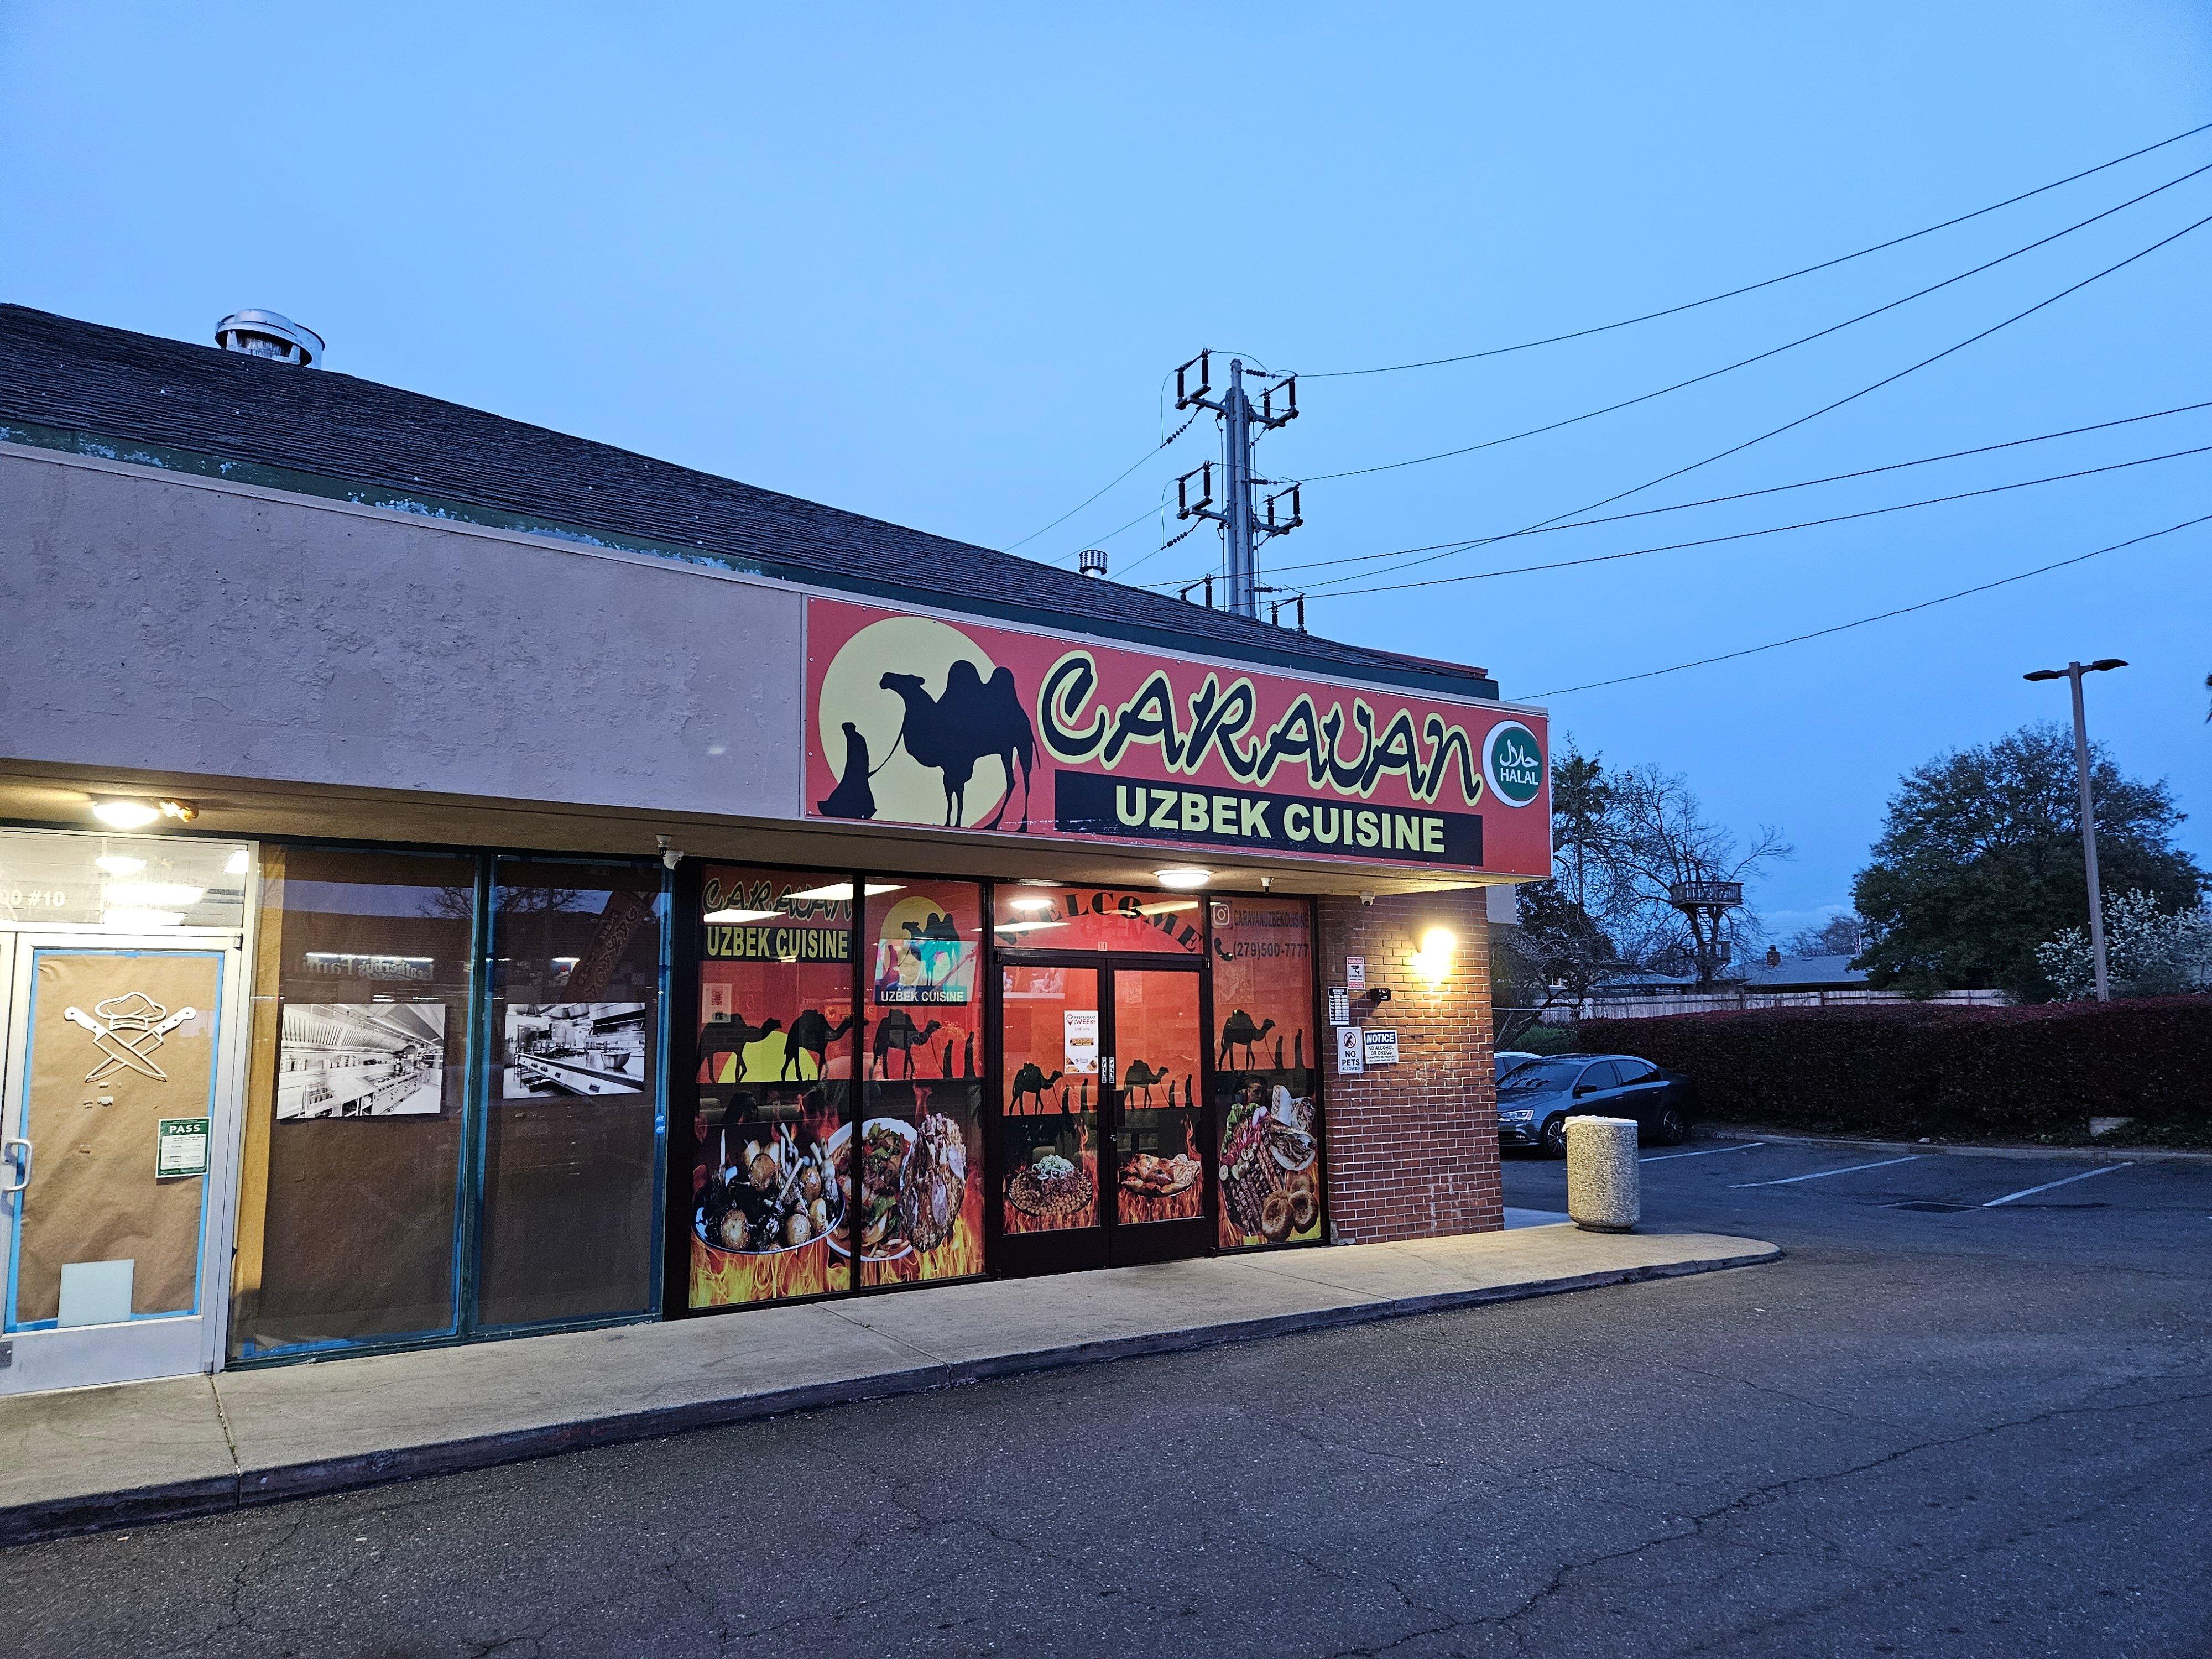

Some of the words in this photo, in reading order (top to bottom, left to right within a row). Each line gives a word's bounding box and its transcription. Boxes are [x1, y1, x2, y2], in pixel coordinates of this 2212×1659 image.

[1037, 650, 1484, 807] CARAVAN
[1499, 739, 1539, 768] حلال
[1500, 767, 1539, 785] HALAL
[1115, 785, 1272, 838] UZBEK
[1283, 804, 1446, 853] CUISINE
[27, 890, 65, 907] #10
[707, 926, 770, 957] UZBEK
[776, 928, 848, 959] CUISINE
[1233, 941, 1310, 961] (279)500-7777
[881, 990, 919, 1002] UZBEK
[921, 990, 964, 1002] CUISINE
[1366, 1033, 1395, 1044] NOTICE
[169, 1124, 201, 1134] PASS
